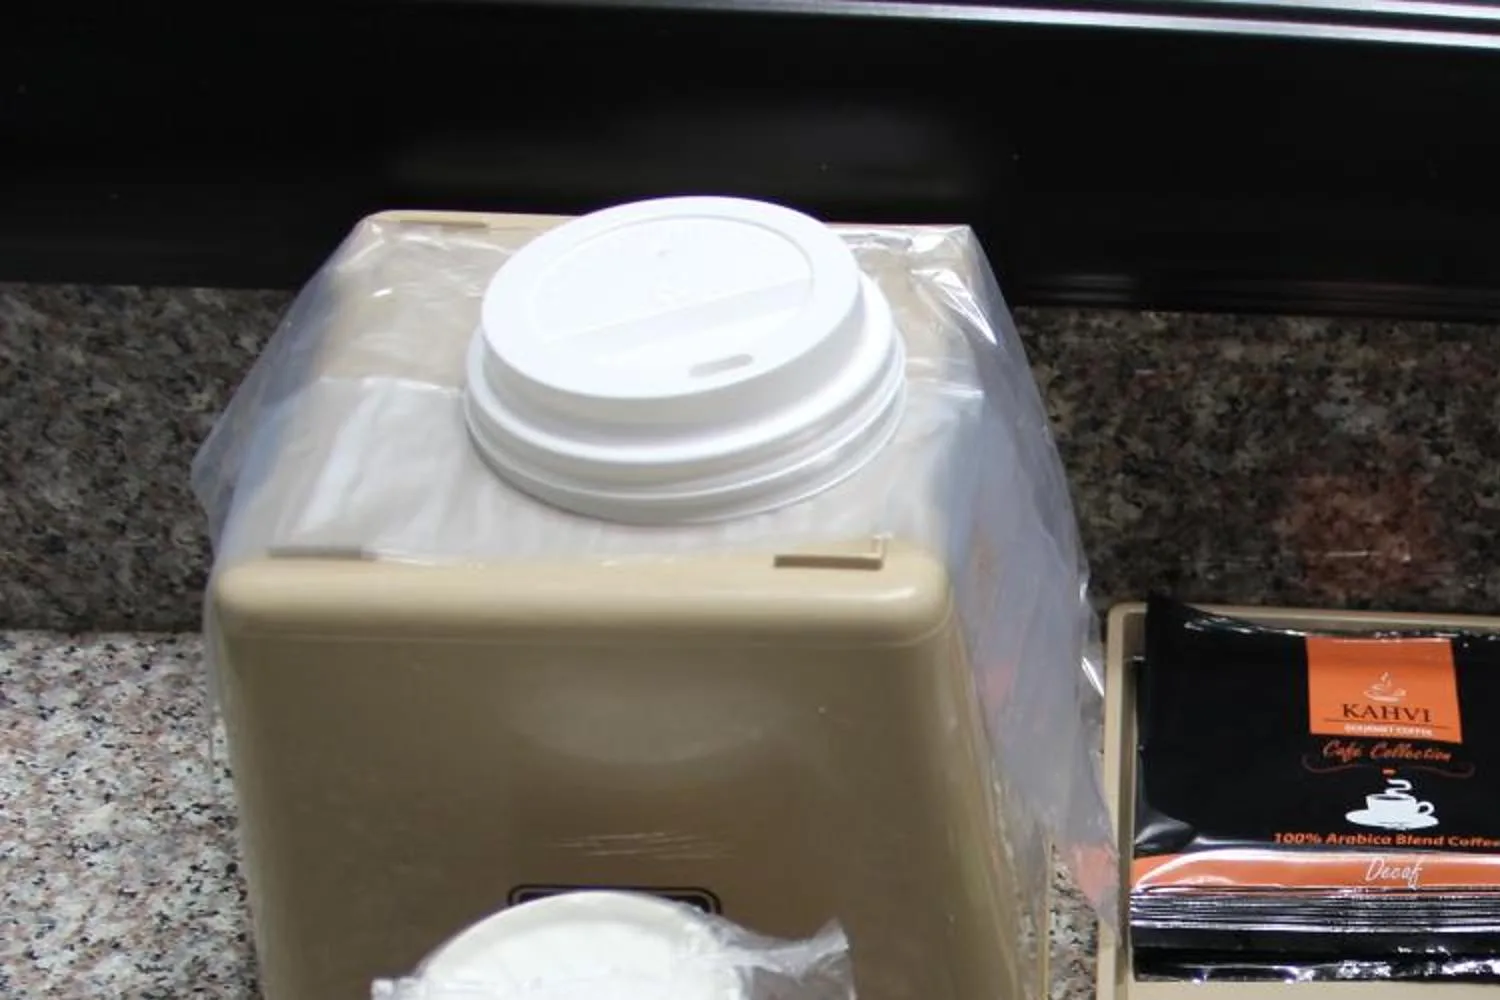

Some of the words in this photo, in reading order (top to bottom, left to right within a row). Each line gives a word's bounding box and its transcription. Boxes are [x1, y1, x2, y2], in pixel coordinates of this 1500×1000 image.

[1342, 703, 1432, 722] KAHVI
[1369, 744, 1452, 762] Collection
[1273, 832, 1322, 844] 100%
[1325, 833, 1391, 845] Arabica
[1396, 835, 1444, 846] Blend
[1365, 853, 1424, 889] Decaf
